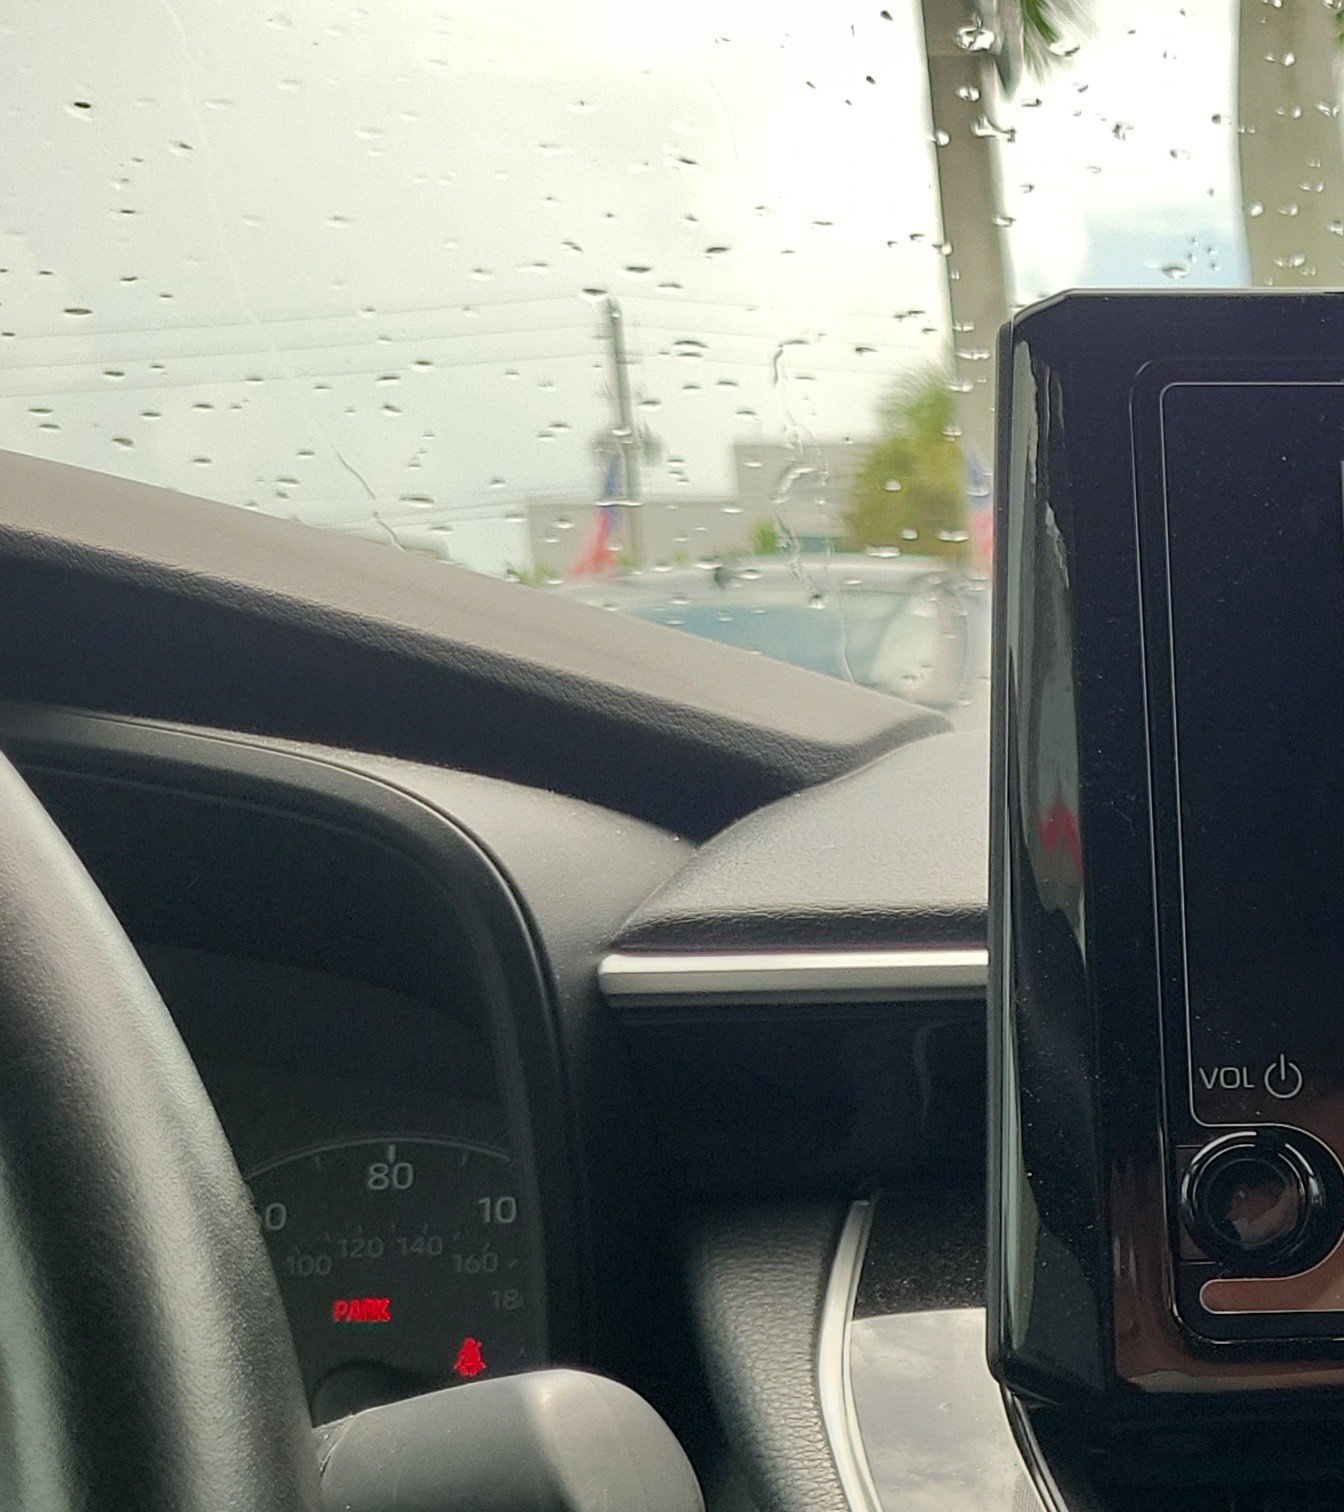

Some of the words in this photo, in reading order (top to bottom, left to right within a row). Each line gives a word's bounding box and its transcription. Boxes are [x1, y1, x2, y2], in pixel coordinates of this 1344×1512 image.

[1198, 1066, 1255, 1090] VOL
[366, 1161, 414, 1191] 80
[262, 1202, 288, 1231] 0
[476, 1195, 518, 1224] 10
[338, 1236, 385, 1259] 120
[396, 1235, 443, 1257] 140
[286, 1254, 333, 1277] 100
[452, 1251, 499, 1274] 160
[332, 1297, 392, 1322] PARK
[490, 1289, 523, 1311] 18
